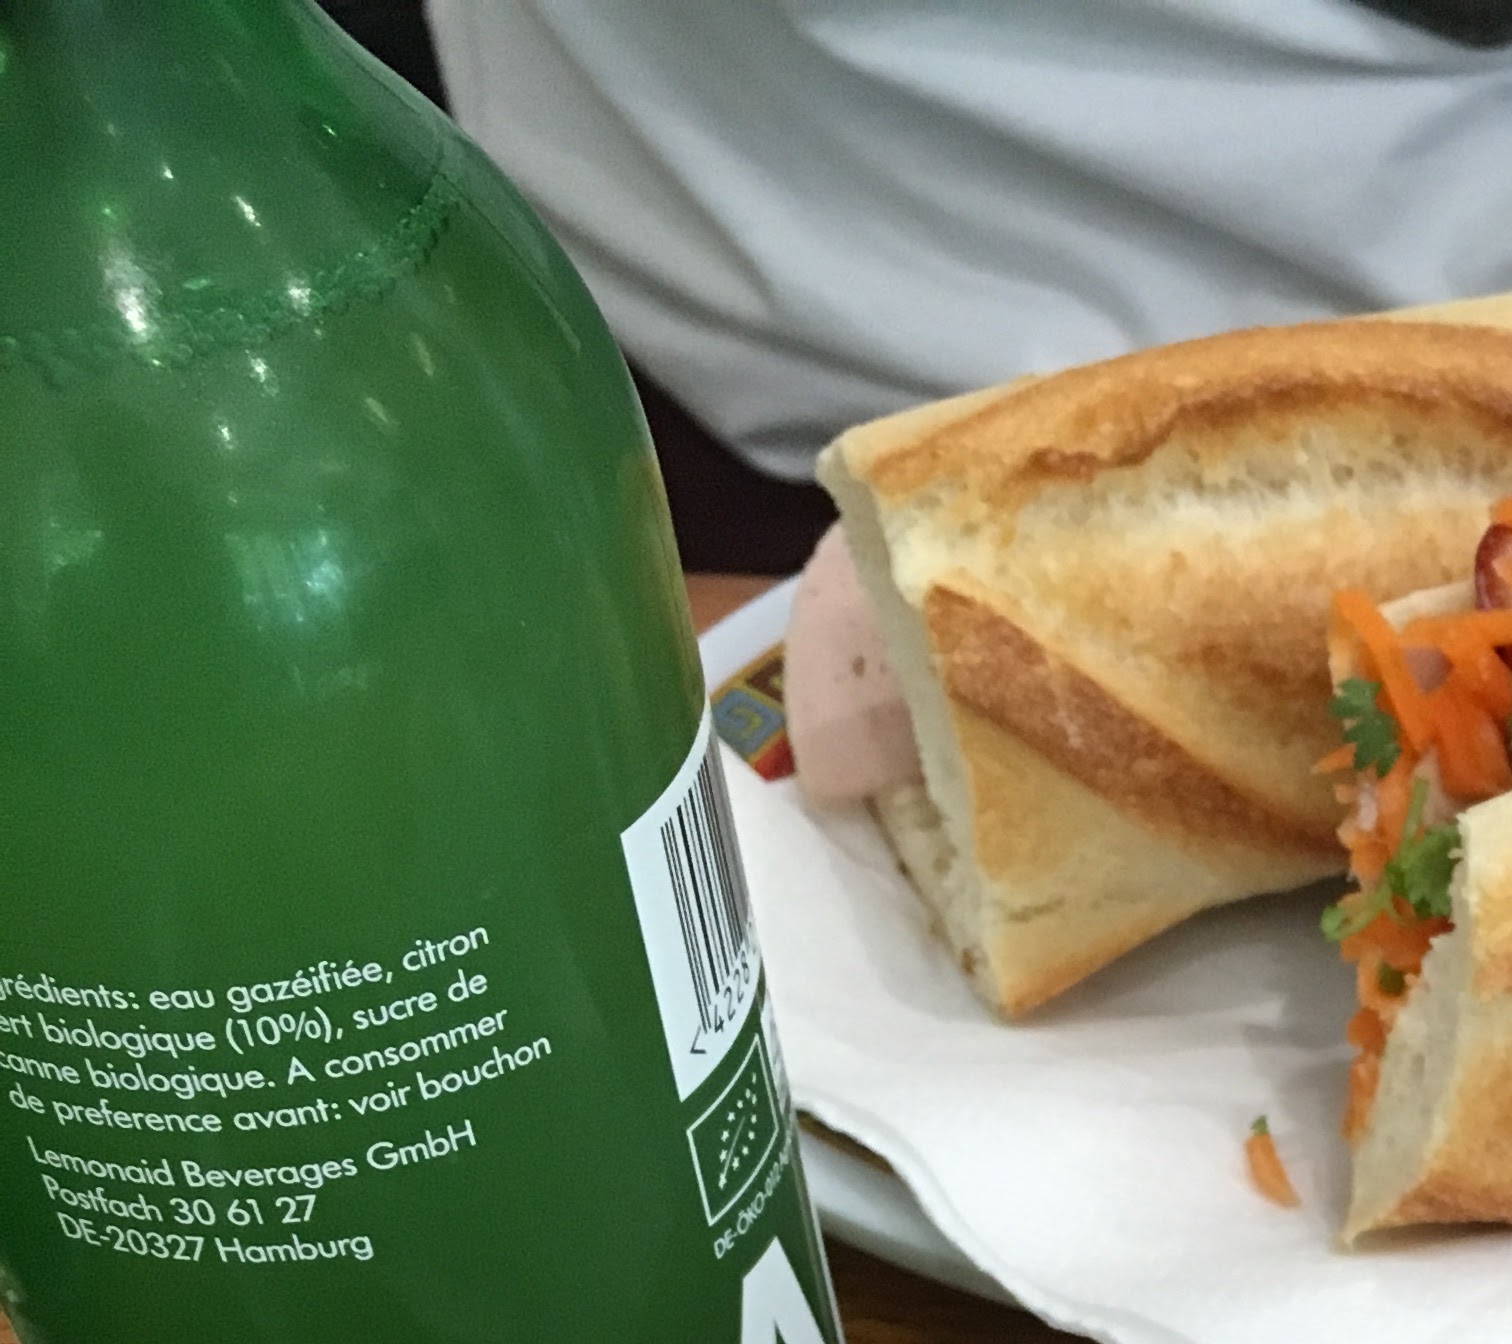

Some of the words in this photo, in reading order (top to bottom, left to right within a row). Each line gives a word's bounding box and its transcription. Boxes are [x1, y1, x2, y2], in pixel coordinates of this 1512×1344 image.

[37, 1012, 217, 1059] biologique
[225, 1005, 344, 1055] (10%),
[352, 991, 438, 1030] sucre
[448, 968, 488, 1003] de
[149, 990, 216, 1011] eau
[226, 960, 393, 1014] gazéifiée,
[402, 926, 490, 972] citron
[9, 1082, 46, 1114] de
[51, 1098, 223, 1133] preference
[233, 1098, 342, 1131] avant:
[347, 1081, 411, 1116] voir
[415, 1037, 552, 1101] bouchon
[84, 1057, 276, 1100] biologique.
[287, 1056, 317, 1086] A
[324, 1009, 508, 1079] consommer
[26, 1135, 176, 1186] Lemonaid
[180, 1158, 358, 1189] Beverages
[366, 1119, 477, 1170] GmbH
[41, 1173, 164, 1222] Postfach
[169, 1197, 216, 1226] 30
[226, 1198, 264, 1226] 61
[275, 1194, 317, 1224] 27
[57, 1211, 205, 1262] DE-20327
[214, 1233, 374, 1263] Hamburg
